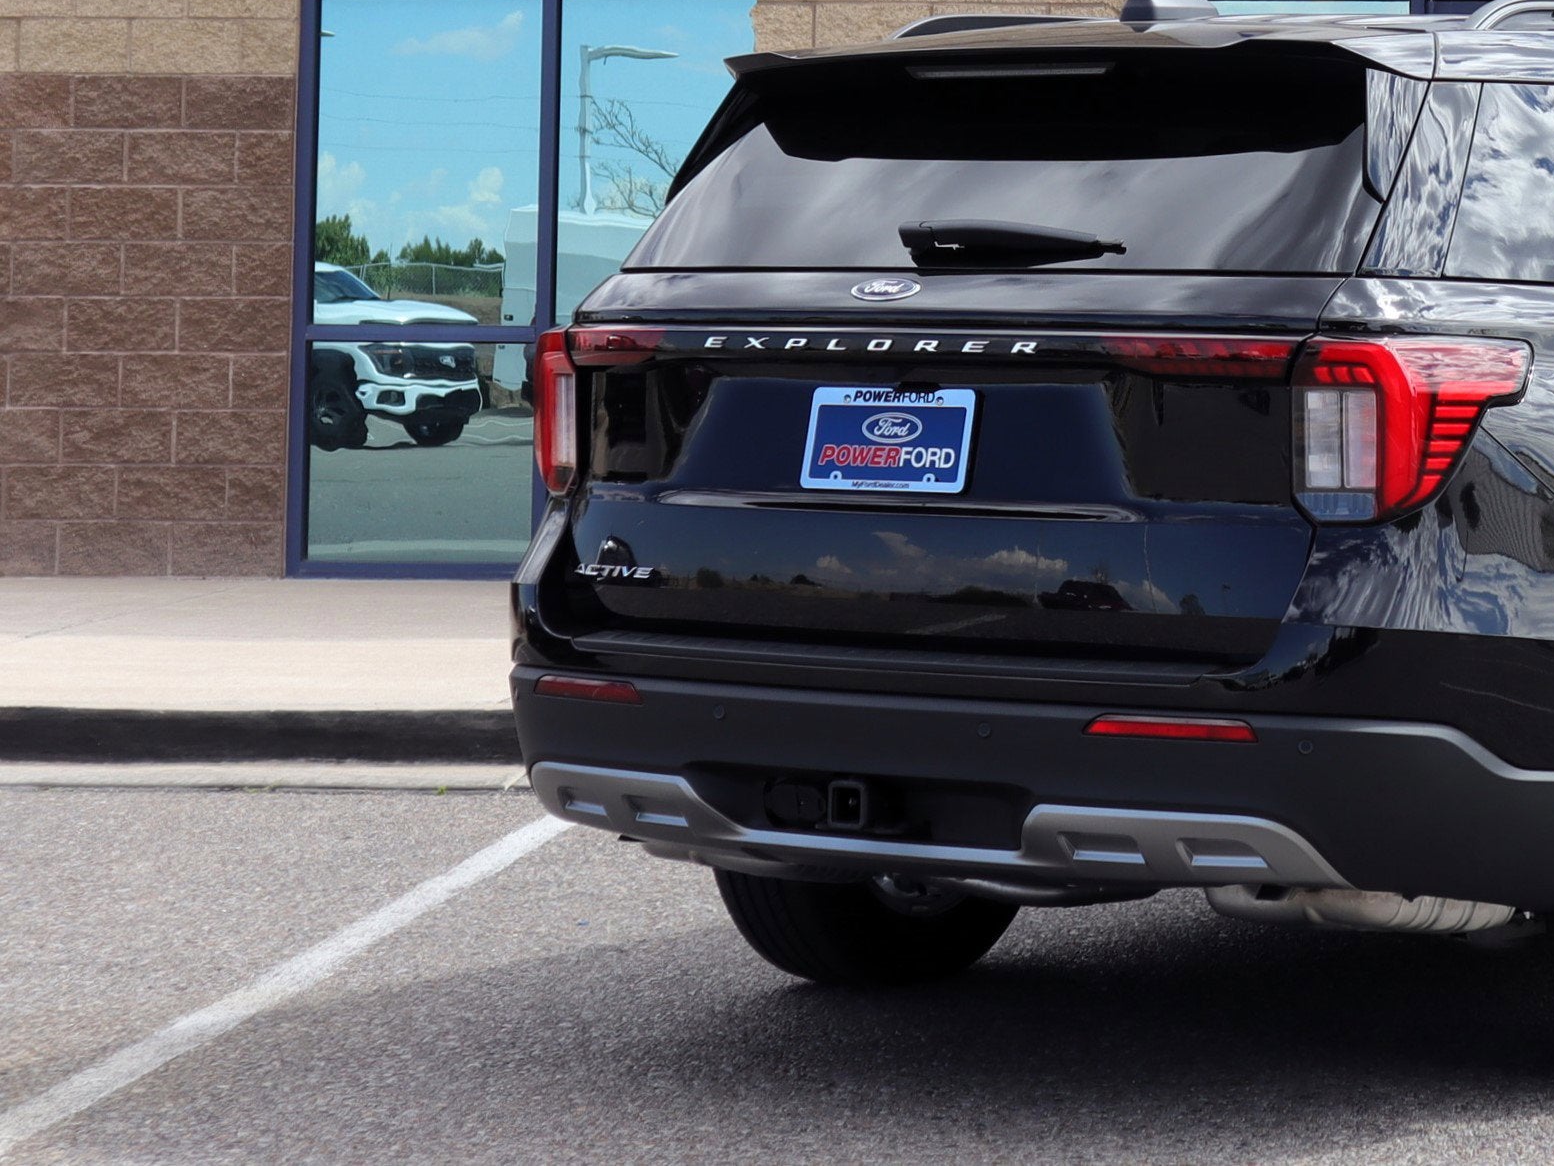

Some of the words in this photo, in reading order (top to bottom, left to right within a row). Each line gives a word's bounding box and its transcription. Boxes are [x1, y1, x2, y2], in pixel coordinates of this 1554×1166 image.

[862, 280, 902, 293] Ford
[703, 336, 1038, 355] EXPLORER
[852, 389, 936, 404] POWERFORD
[873, 417, 909, 437] Ford
[818, 444, 956, 469] POWERFORD
[574, 563, 654, 581] ACTIVE
